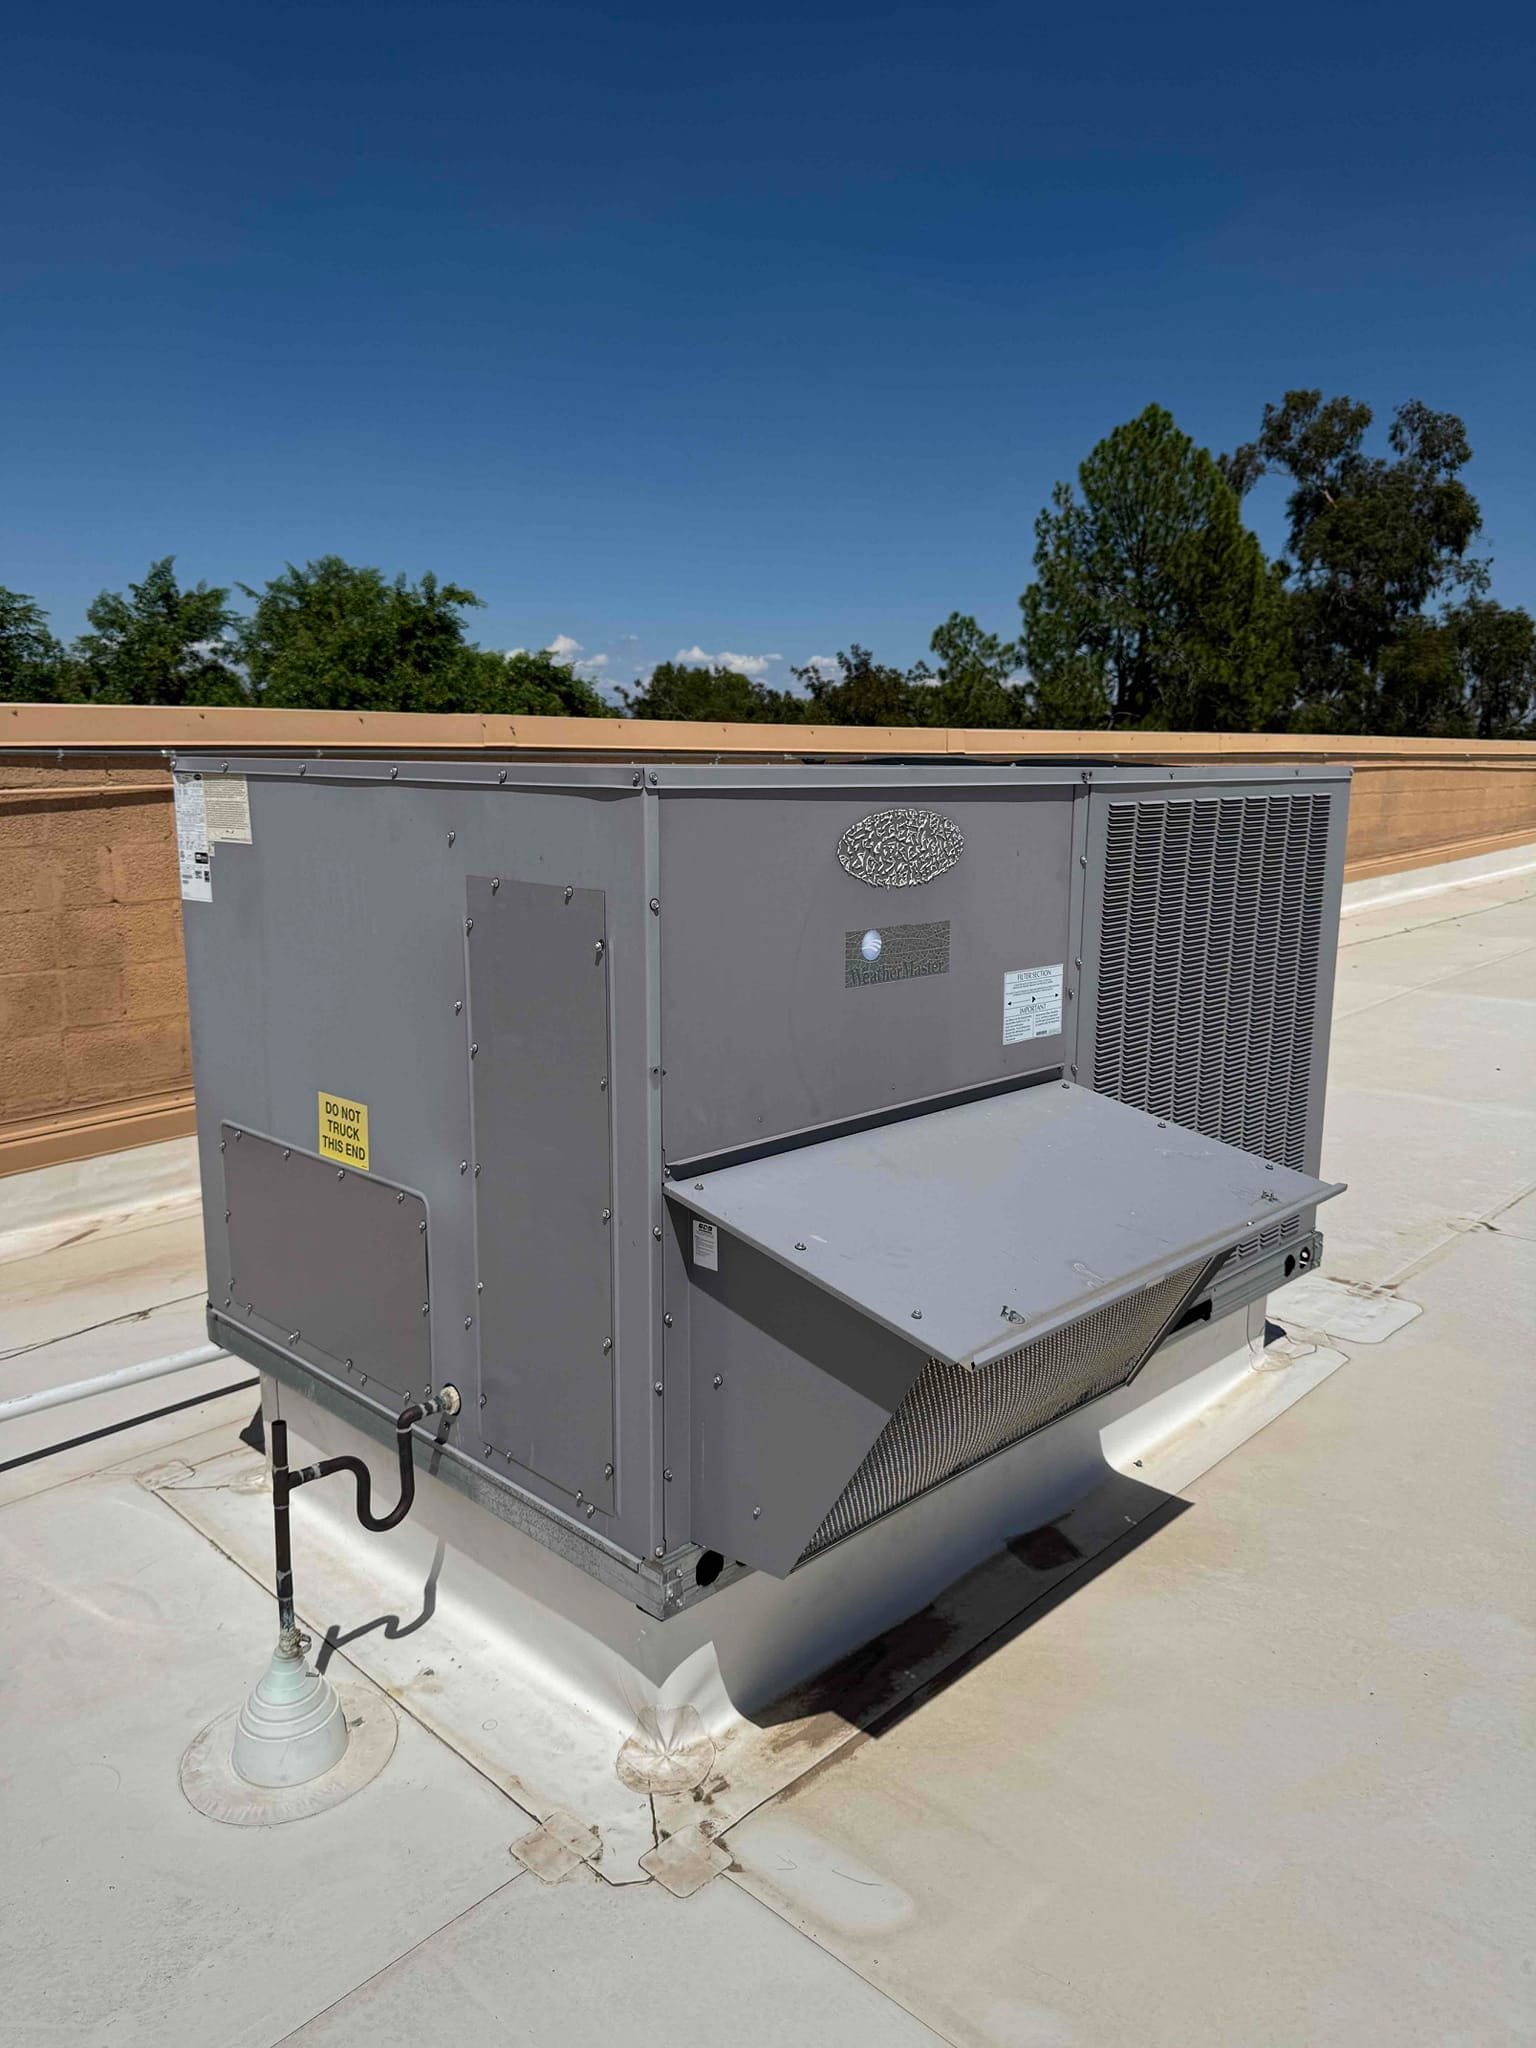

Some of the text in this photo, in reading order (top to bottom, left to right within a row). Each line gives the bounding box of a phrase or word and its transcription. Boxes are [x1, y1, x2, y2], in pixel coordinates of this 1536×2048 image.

[1020, 1003, 1046, 1014] IMPORTANT
[325, 1101, 361, 1123] DO NOT
[327, 1119, 360, 1141] TRUCK
[322, 1134, 366, 1160] THIS END
